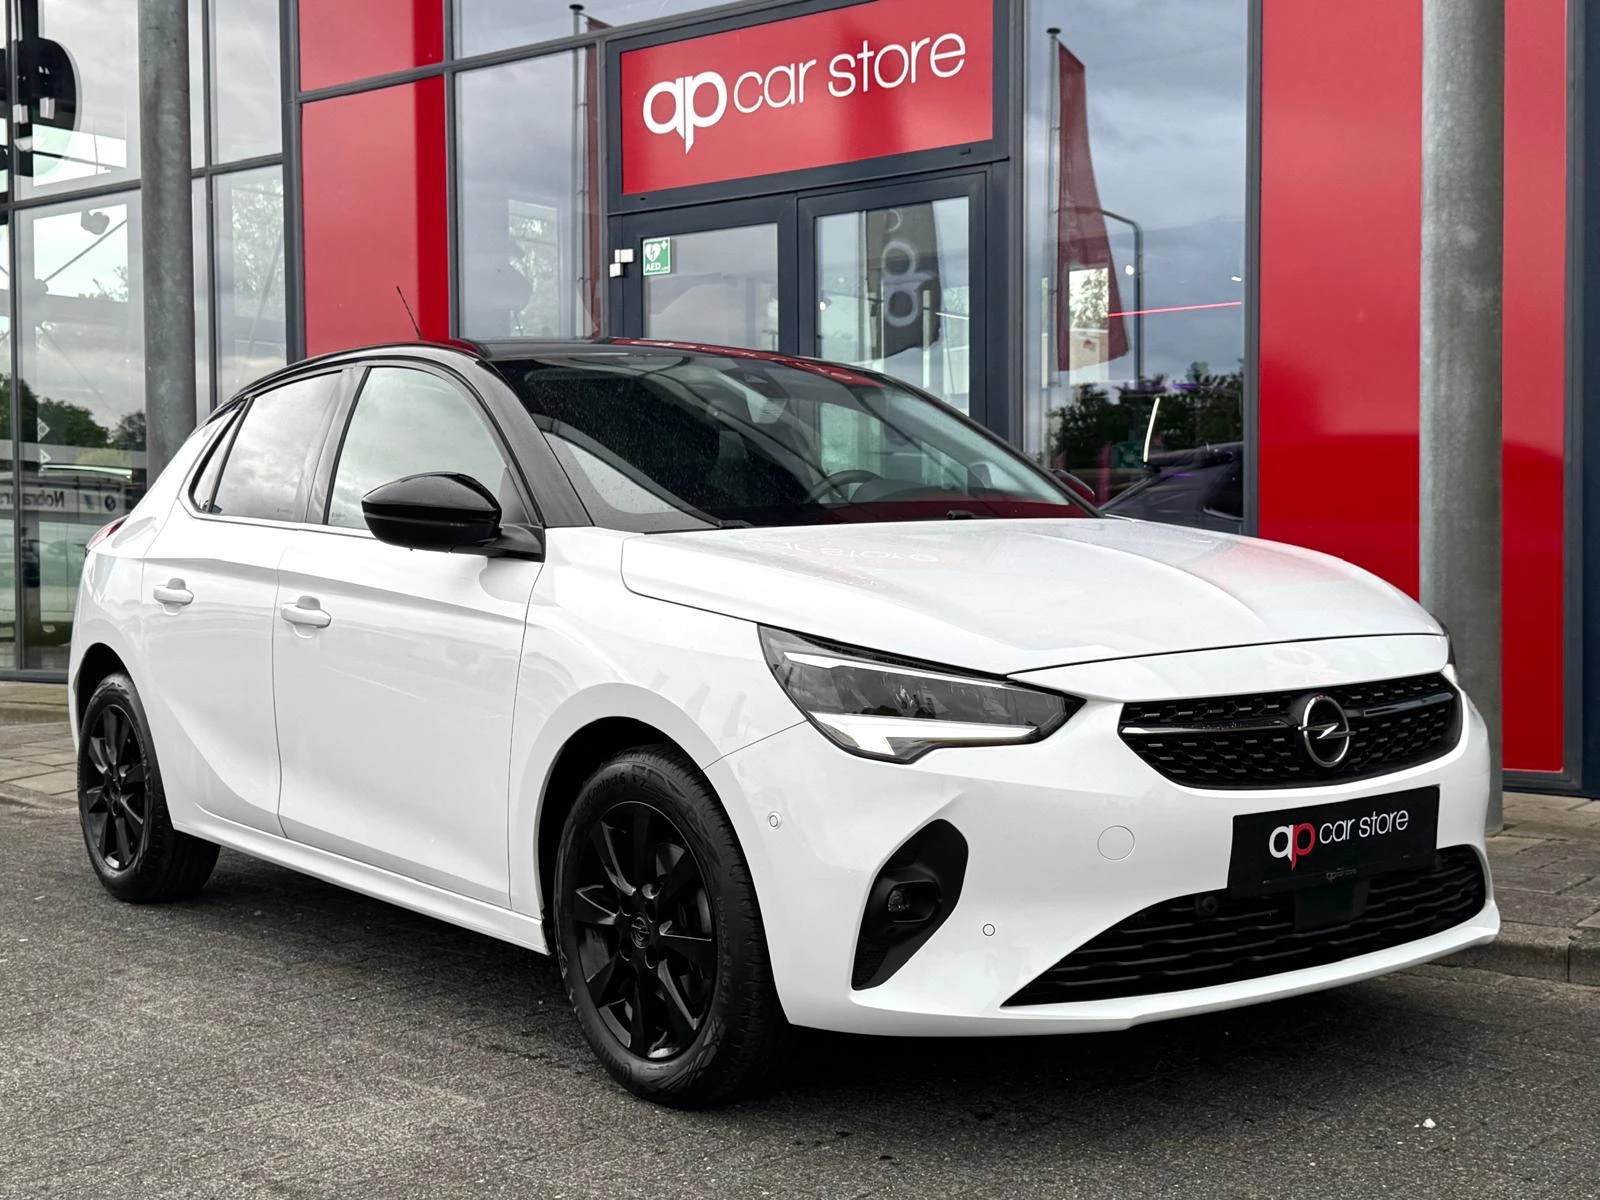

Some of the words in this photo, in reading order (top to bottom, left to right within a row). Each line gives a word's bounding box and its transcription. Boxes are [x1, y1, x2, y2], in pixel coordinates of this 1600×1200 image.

[643, 71, 728, 155] ap
[733, 59, 816, 114] car
[828, 33, 966, 98] store
[645, 262, 661, 272] AED
[1268, 822, 1316, 871] ap
[1319, 818, 1356, 844] car
[1358, 810, 1409, 838] store
